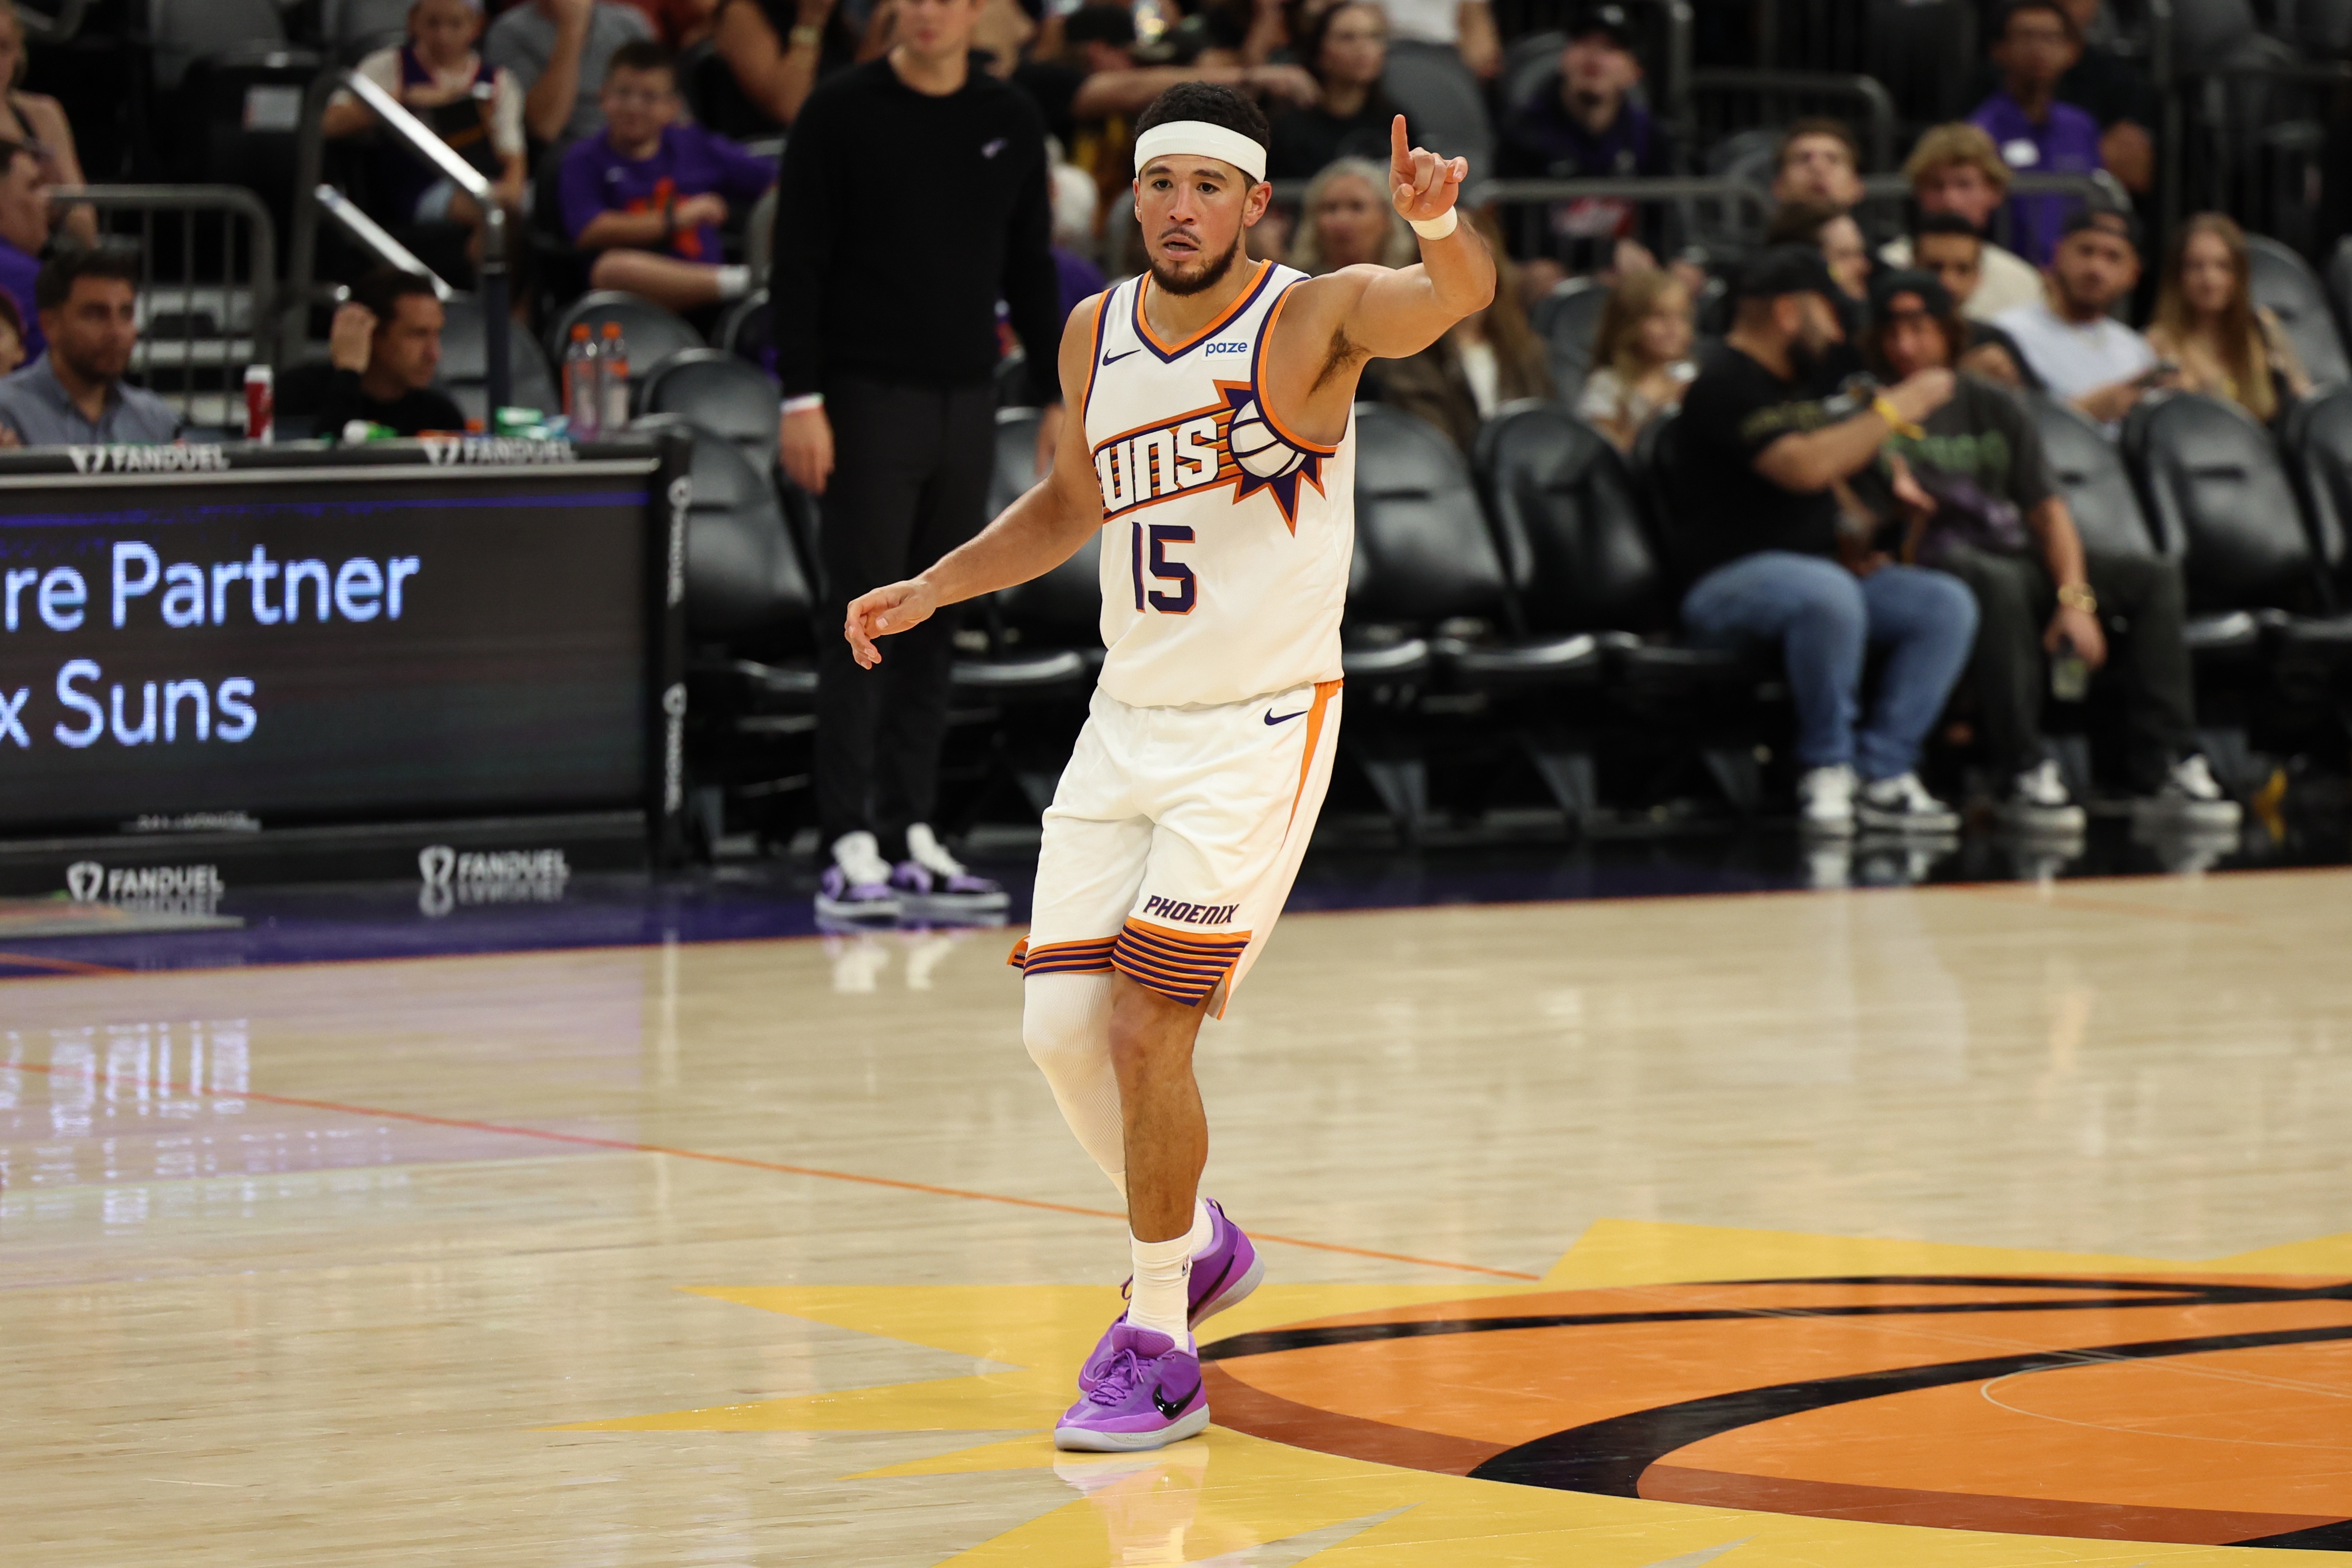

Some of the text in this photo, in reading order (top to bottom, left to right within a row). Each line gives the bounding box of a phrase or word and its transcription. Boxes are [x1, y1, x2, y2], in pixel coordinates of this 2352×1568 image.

[1205, 342, 1248, 357] paze
[111, 444, 230, 472] FANDUEL
[1095, 416, 1219, 513] UNS
[112, 540, 420, 630] Partner
[1132, 521, 1196, 615] 15
[54, 659, 257, 749] Suns
[107, 865, 225, 898] FANDUEL
[1143, 895, 1240, 925] PHOENIX
